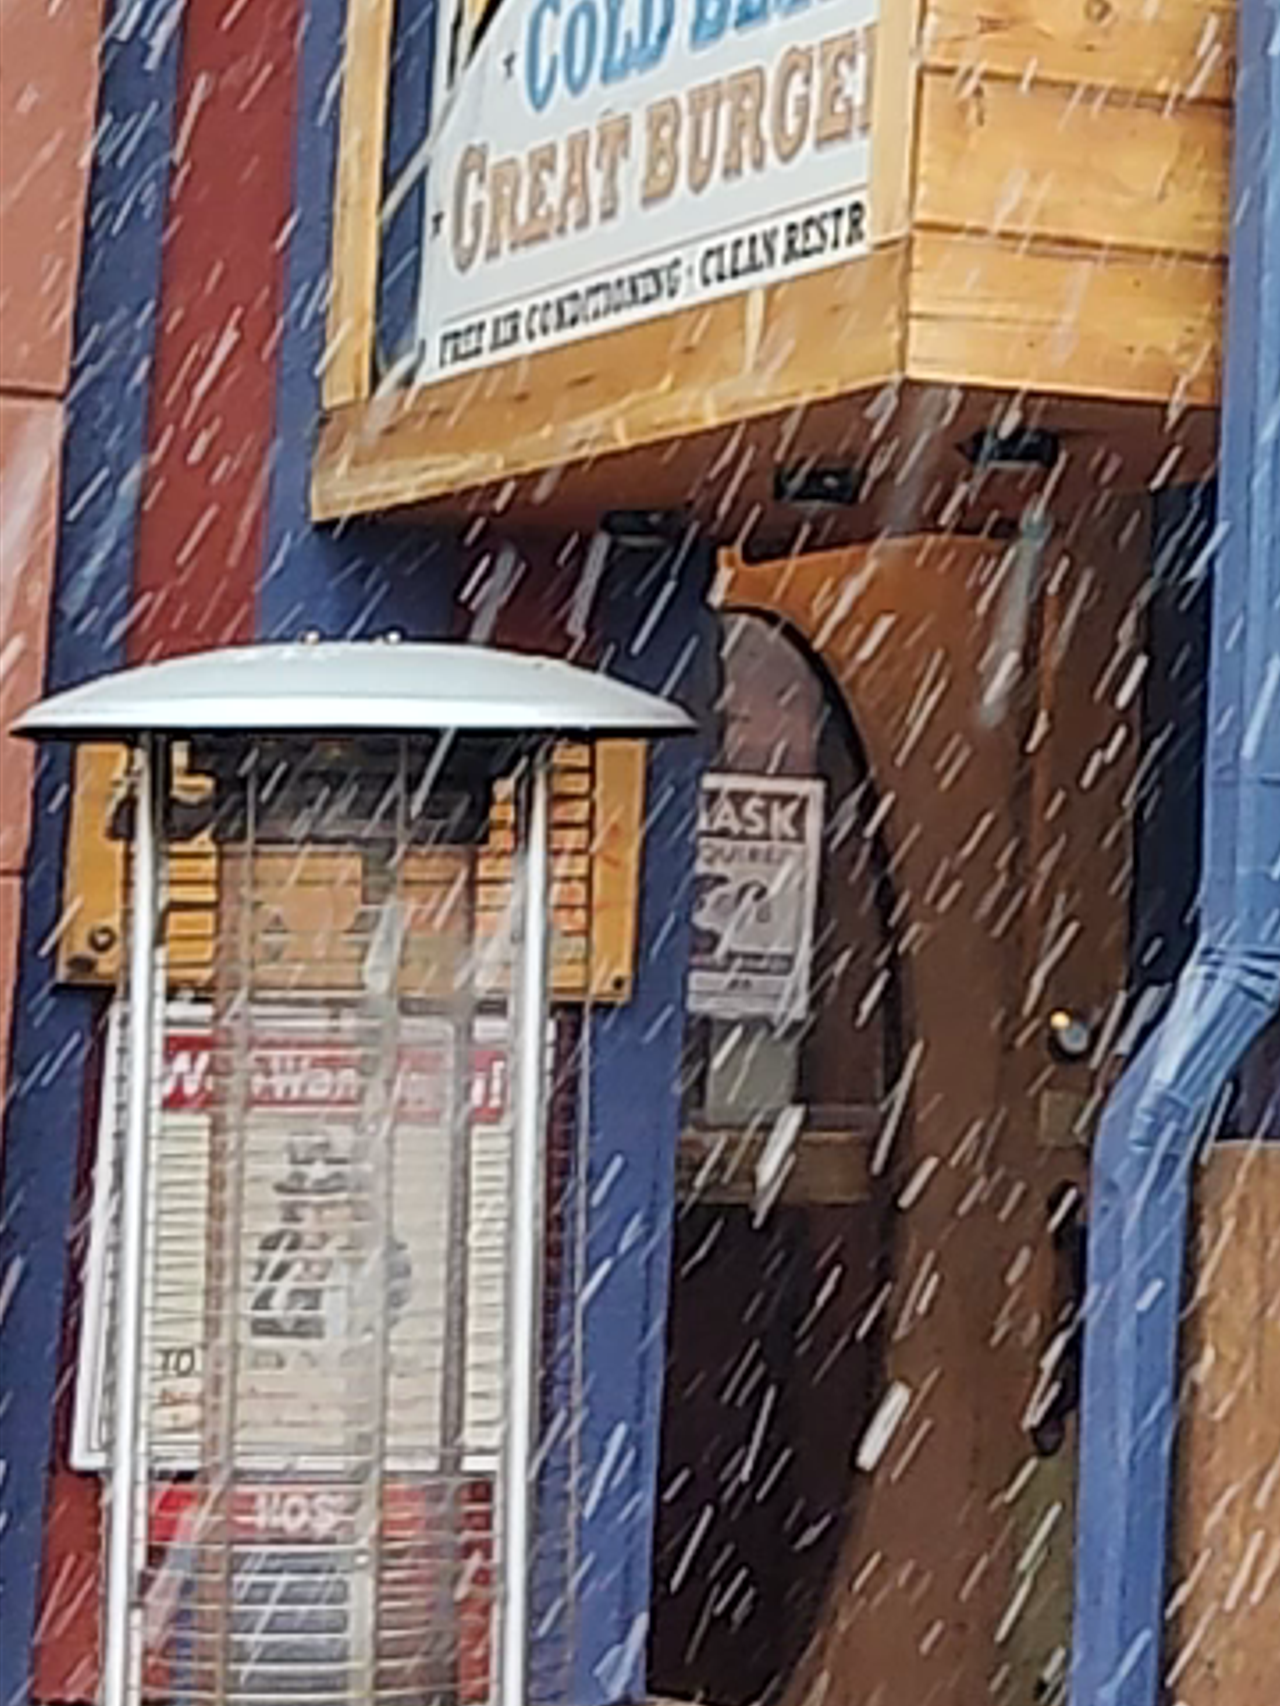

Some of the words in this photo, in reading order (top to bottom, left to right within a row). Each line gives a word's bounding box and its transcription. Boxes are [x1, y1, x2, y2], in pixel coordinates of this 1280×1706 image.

[449, 110, 632, 274] GREAT
[439, 320, 489, 369] FREE
[489, 305, 520, 352] AIR
[524, 258, 683, 338] CONDITIONING
[699, 222, 782, 288] CLEAN
